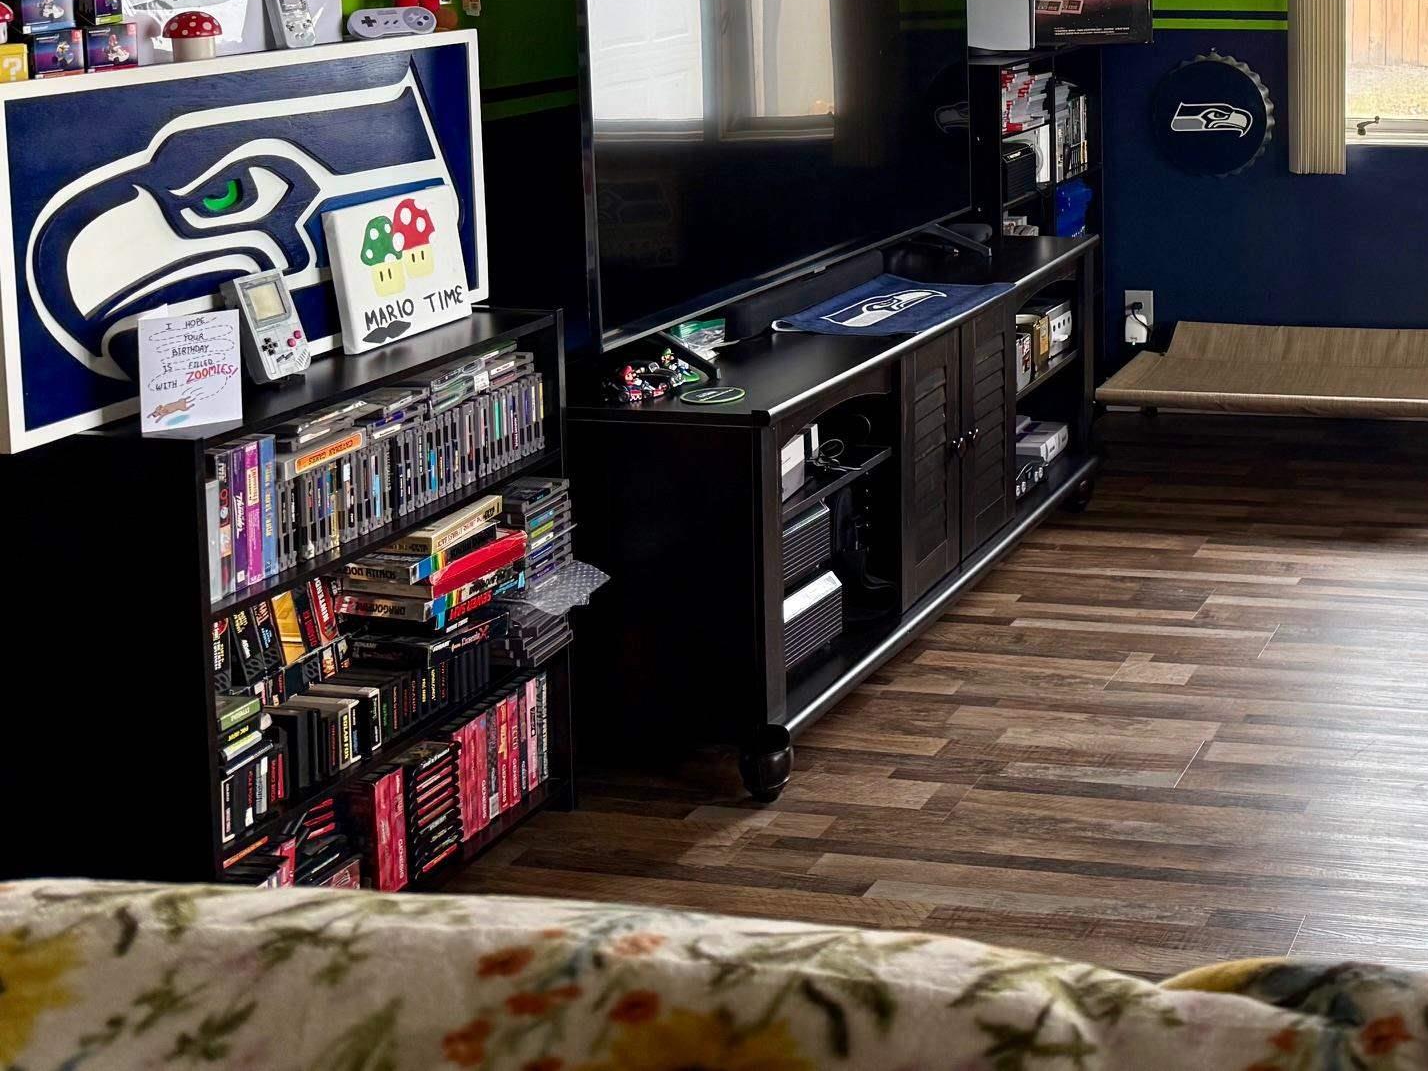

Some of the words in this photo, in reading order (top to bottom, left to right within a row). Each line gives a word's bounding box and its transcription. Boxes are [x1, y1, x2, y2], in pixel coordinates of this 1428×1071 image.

[364, 298, 414, 331] MARIO
[423, 285, 464, 313] TIME
[165, 323, 172, 331] I
[185, 317, 205, 329] HOPE
[184, 333, 204, 342] YOUR
[171, 344, 210, 358] BIRTHDAY
[162, 363, 173, 373] IS
[188, 358, 213, 370] FILLED
[155, 379, 178, 392] WITH
[186, 363, 239, 385] ZOOMIES!
[342, 714, 350, 741] SOLAR
[342, 742, 350, 761] FOX
